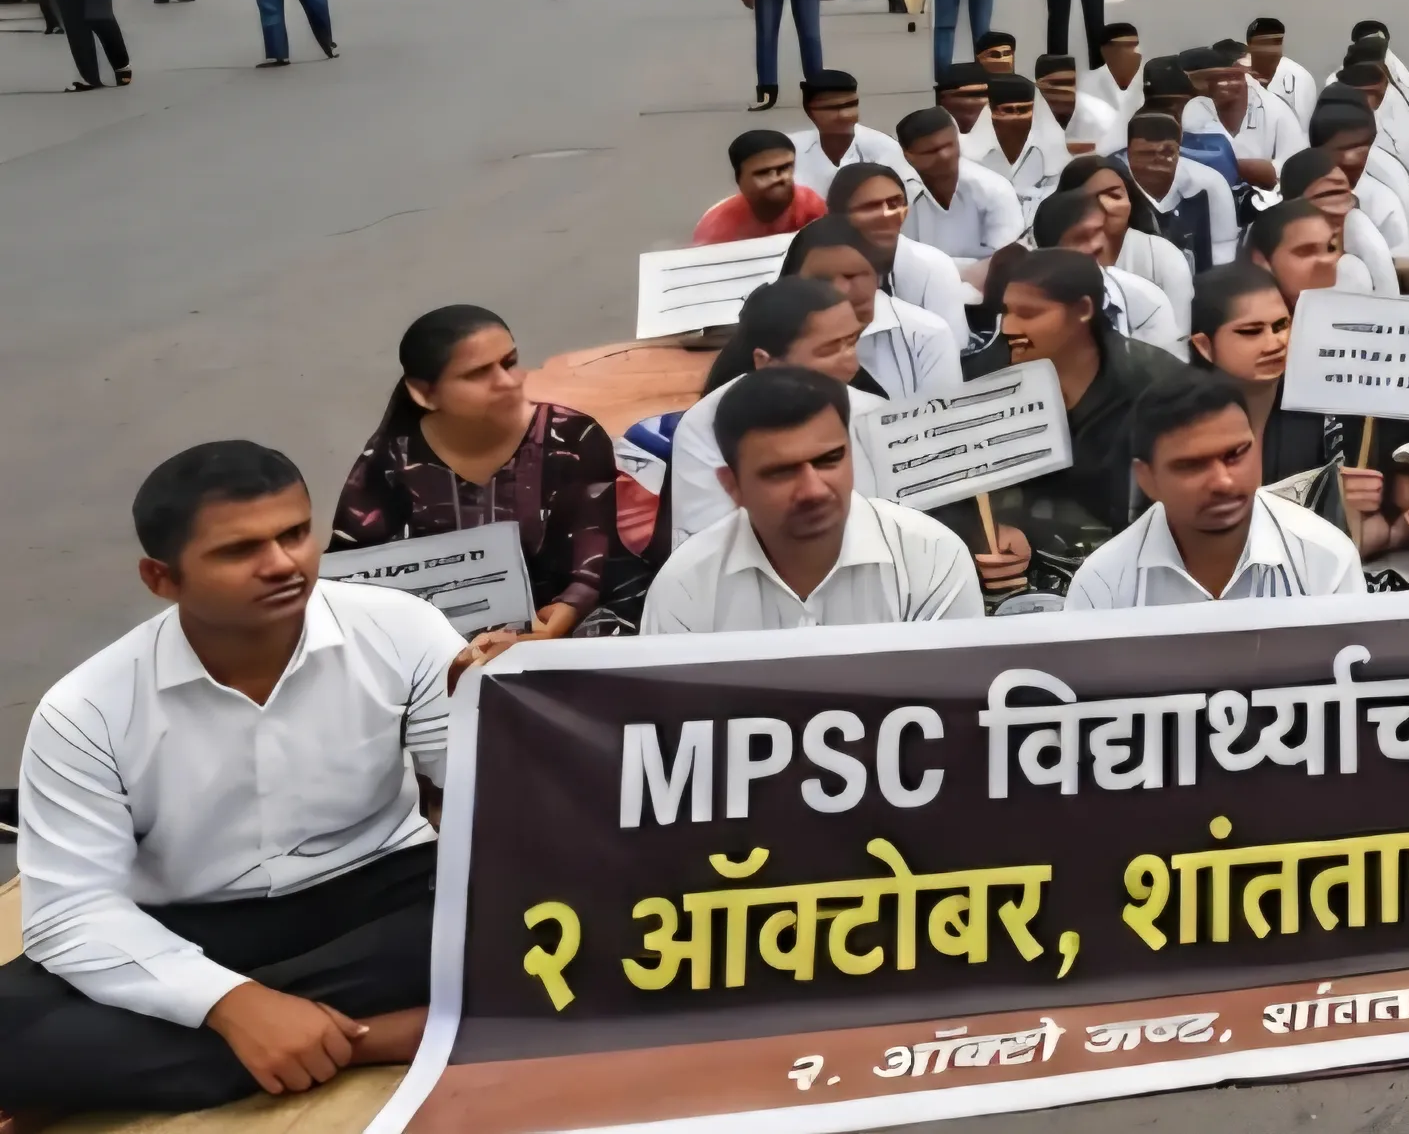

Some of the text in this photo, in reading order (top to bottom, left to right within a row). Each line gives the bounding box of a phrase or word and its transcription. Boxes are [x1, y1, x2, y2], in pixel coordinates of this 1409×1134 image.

[619, 705, 945, 828] MPSC
[523, 901, 581, 1011] २
[623, 839, 1080, 990] ऑक्टोबर,
